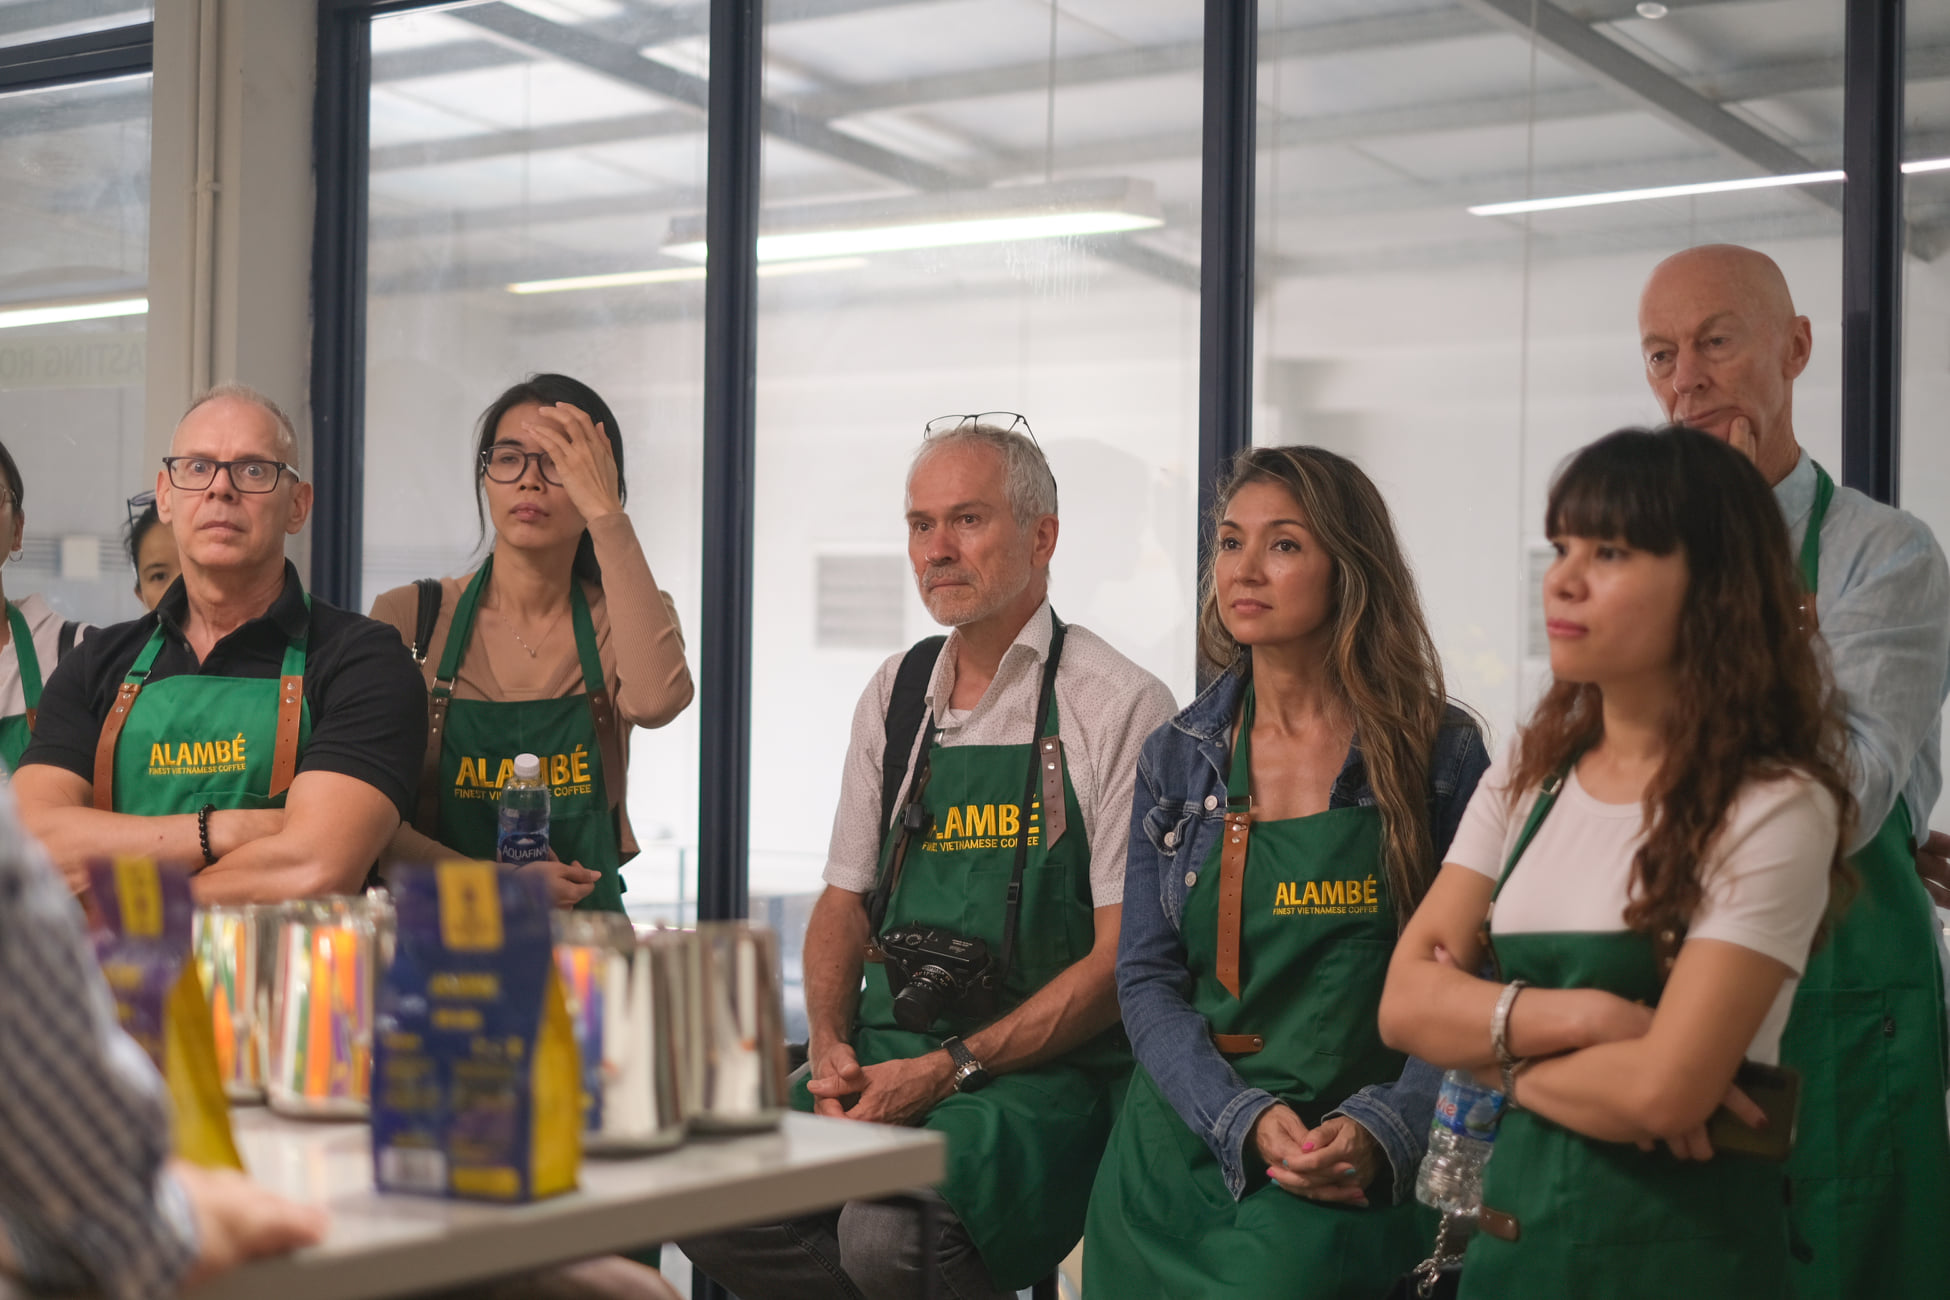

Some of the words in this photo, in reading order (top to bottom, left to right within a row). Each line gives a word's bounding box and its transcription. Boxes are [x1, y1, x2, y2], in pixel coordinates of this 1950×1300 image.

[150, 732, 247, 766] ALAMBÉ
[148, 767, 170, 776] FINEST
[171, 765, 217, 775] VIETNAMESE
[218, 763, 246, 773] COFFEE
[454, 788, 485, 800] FINEST
[554, 783, 592, 797] COFFEE
[502, 844, 547, 859] AQUAFINA
[940, 839, 998, 852] VIETNAMESE
[1000, 836, 1039, 849] COEE
[1275, 874, 1378, 906] ALAMBÉ
[1273, 907, 1295, 916] FINEST
[1297, 905, 1347, 915] VIETNAMESE
[1348, 905, 1379, 914] COFFEE
